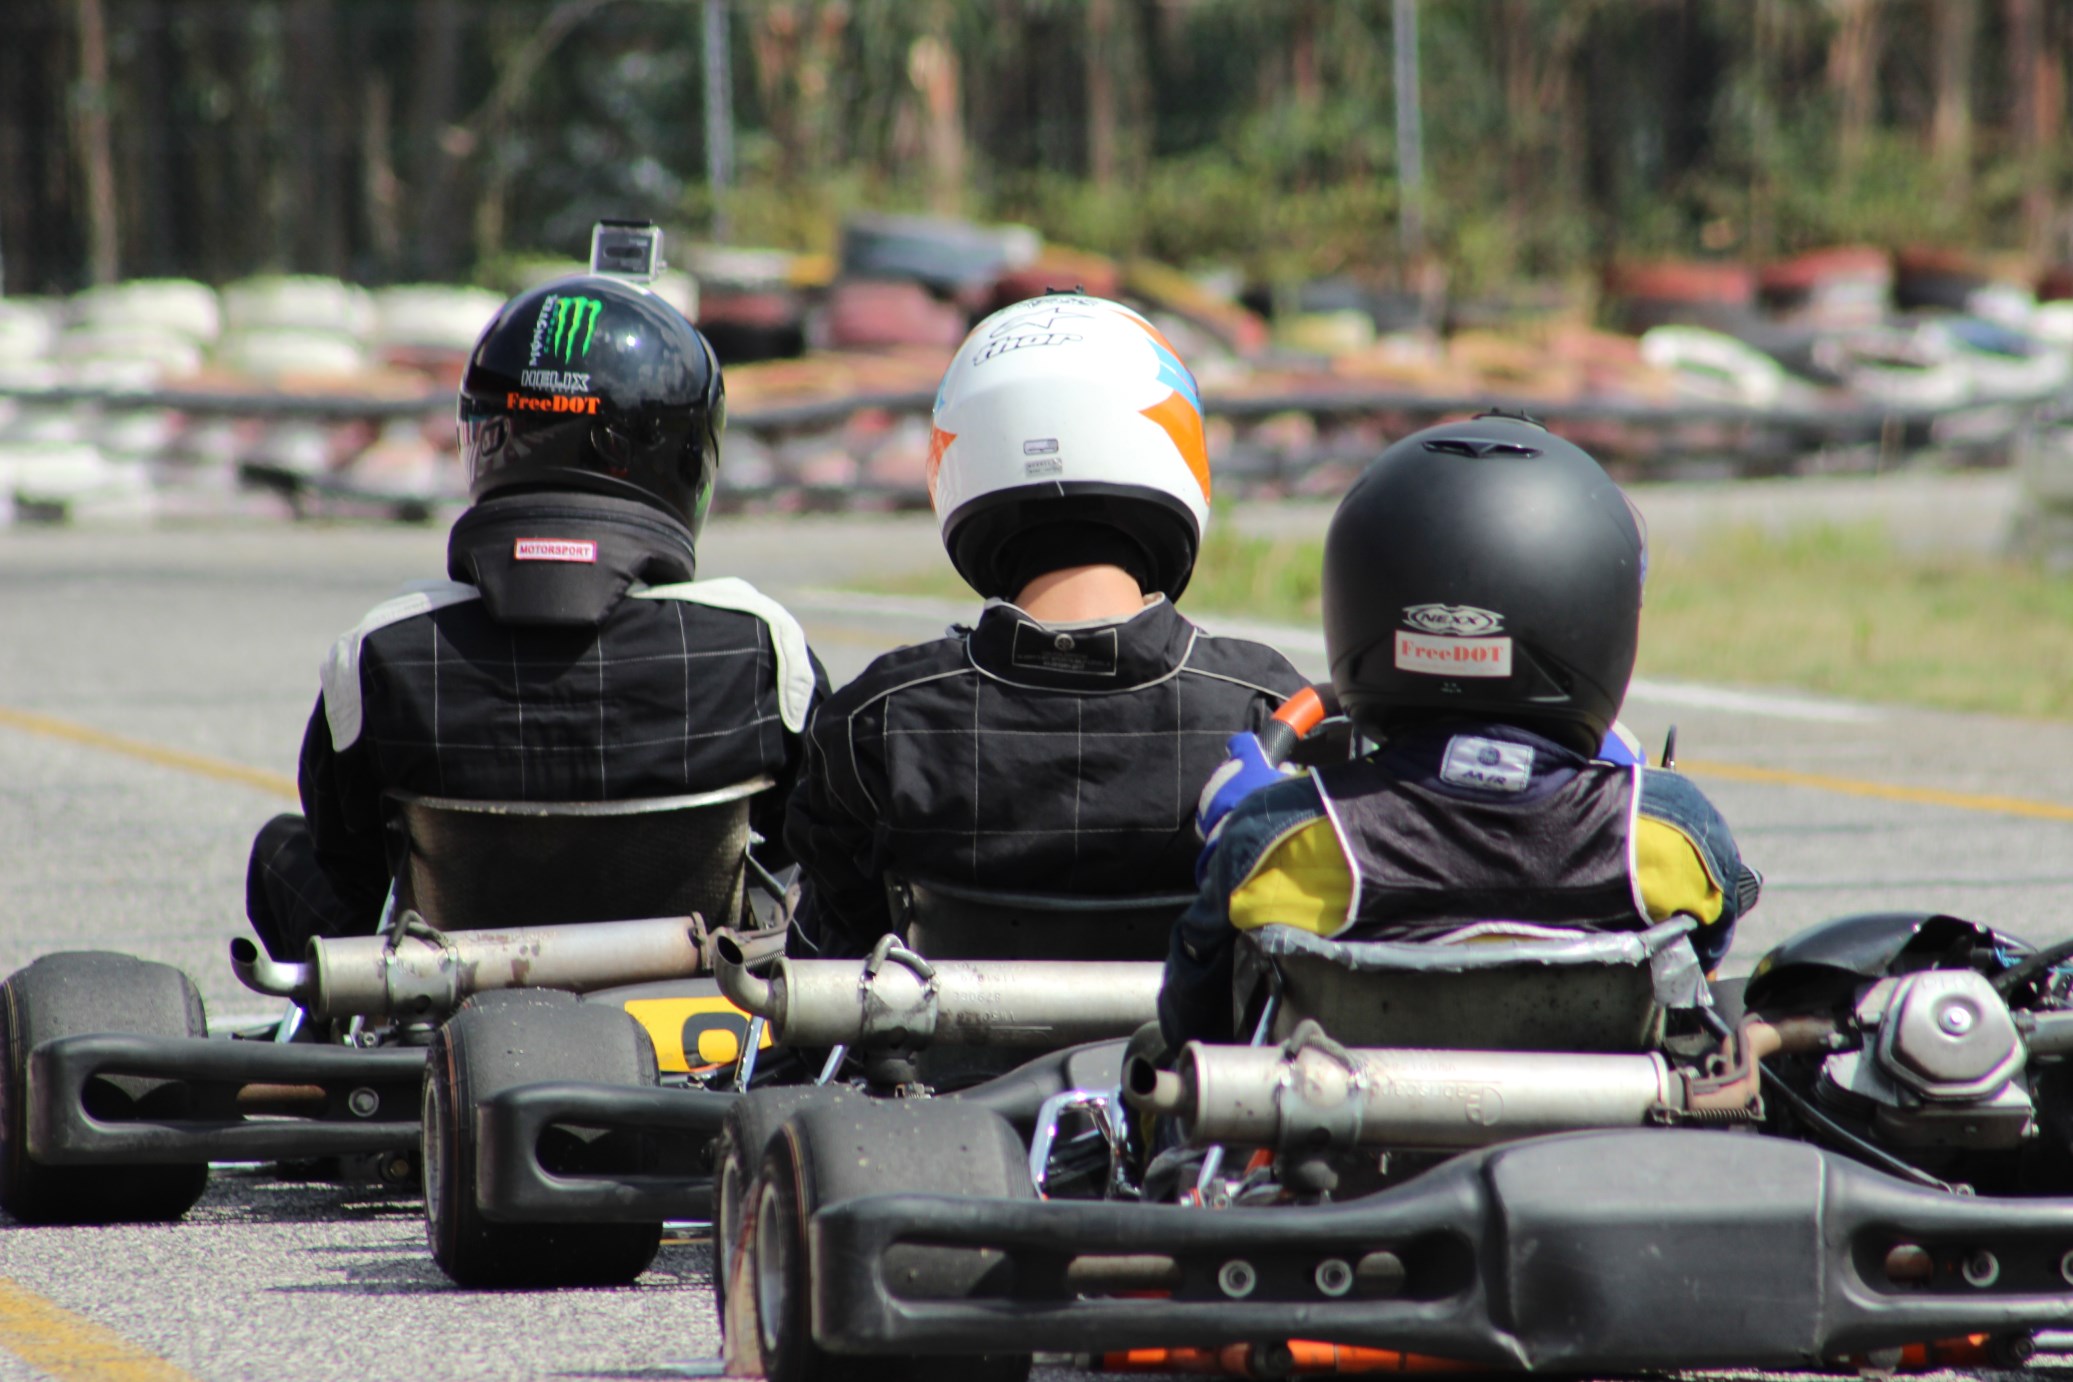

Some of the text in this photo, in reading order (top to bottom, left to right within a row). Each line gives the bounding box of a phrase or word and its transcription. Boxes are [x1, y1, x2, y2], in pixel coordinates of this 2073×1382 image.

[506, 391, 600, 415] FreeDOT
[520, 545, 590, 556] MOTORSPORT
[1420, 612, 1481, 625] NEXX
[1401, 639, 1504, 663] FreeDOT
